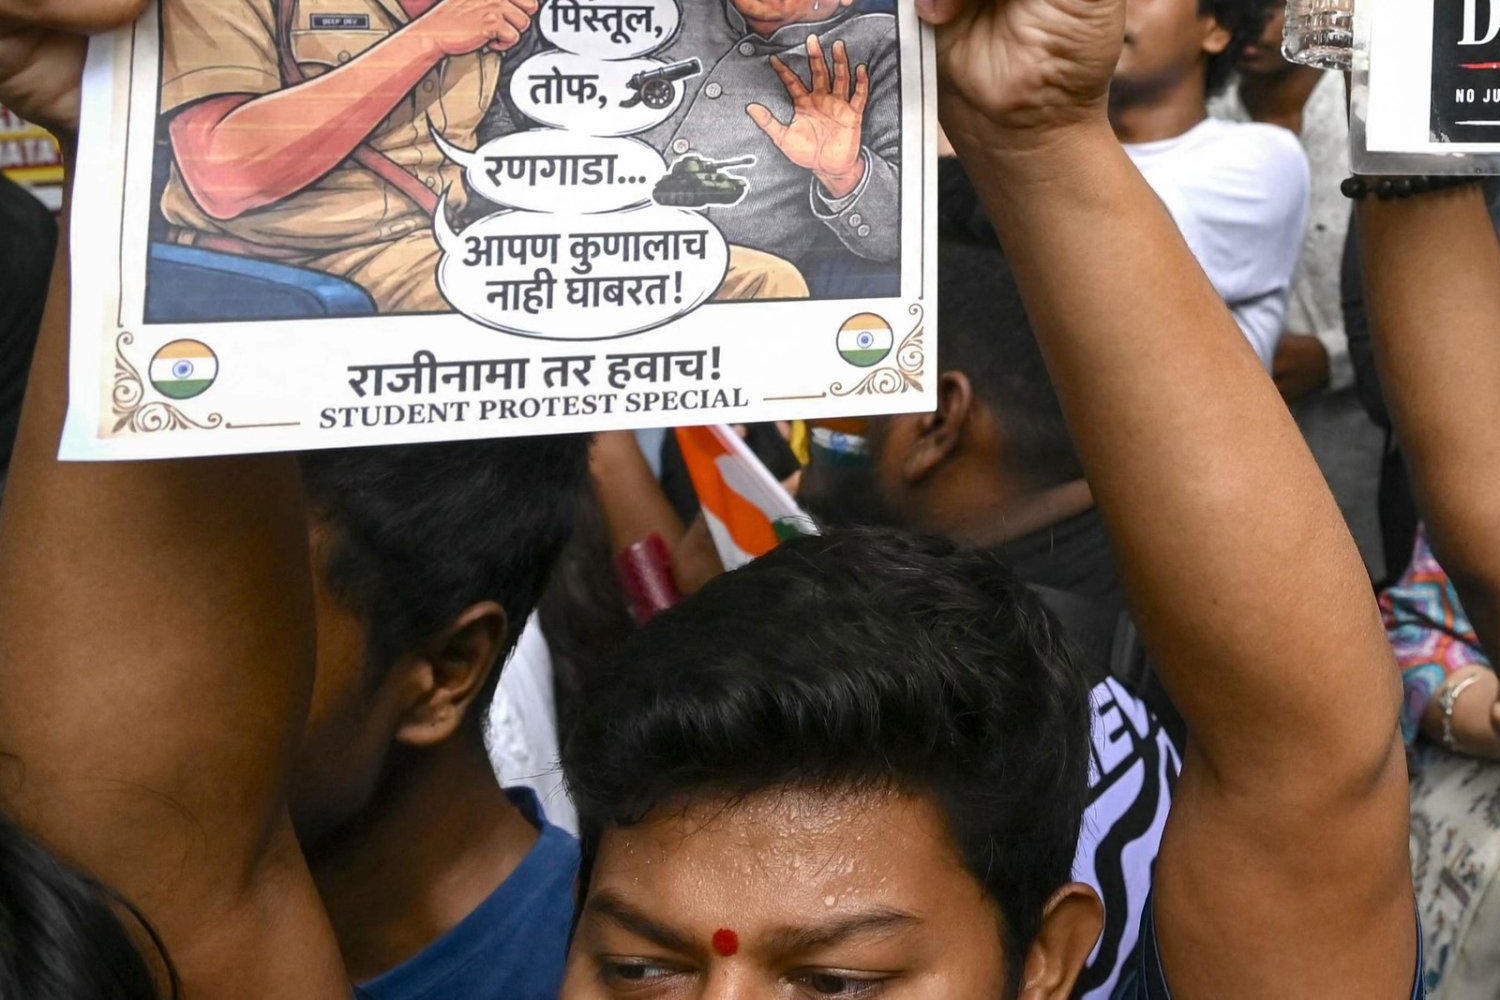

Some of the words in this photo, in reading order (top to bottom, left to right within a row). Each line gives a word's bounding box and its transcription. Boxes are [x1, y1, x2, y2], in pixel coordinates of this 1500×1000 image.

[528, 66, 607, 108] तोफ,
[1455, 88, 1475, 103] NO
[484, 154, 646, 187] रणगाडा...
[462, 234, 561, 266] आपण
[568, 230, 708, 274] कुणालाच
[485, 267, 557, 314] नाही
[564, 271, 682, 307] घाबरत!
[348, 349, 529, 398] राजीनामा
[542, 354, 595, 389] तर
[606, 346, 722, 389] हवाच!
[319, 402, 470, 429] STUDENT
[479, 394, 618, 420] PROTEST
[625, 388, 749, 412] SPECIAL
